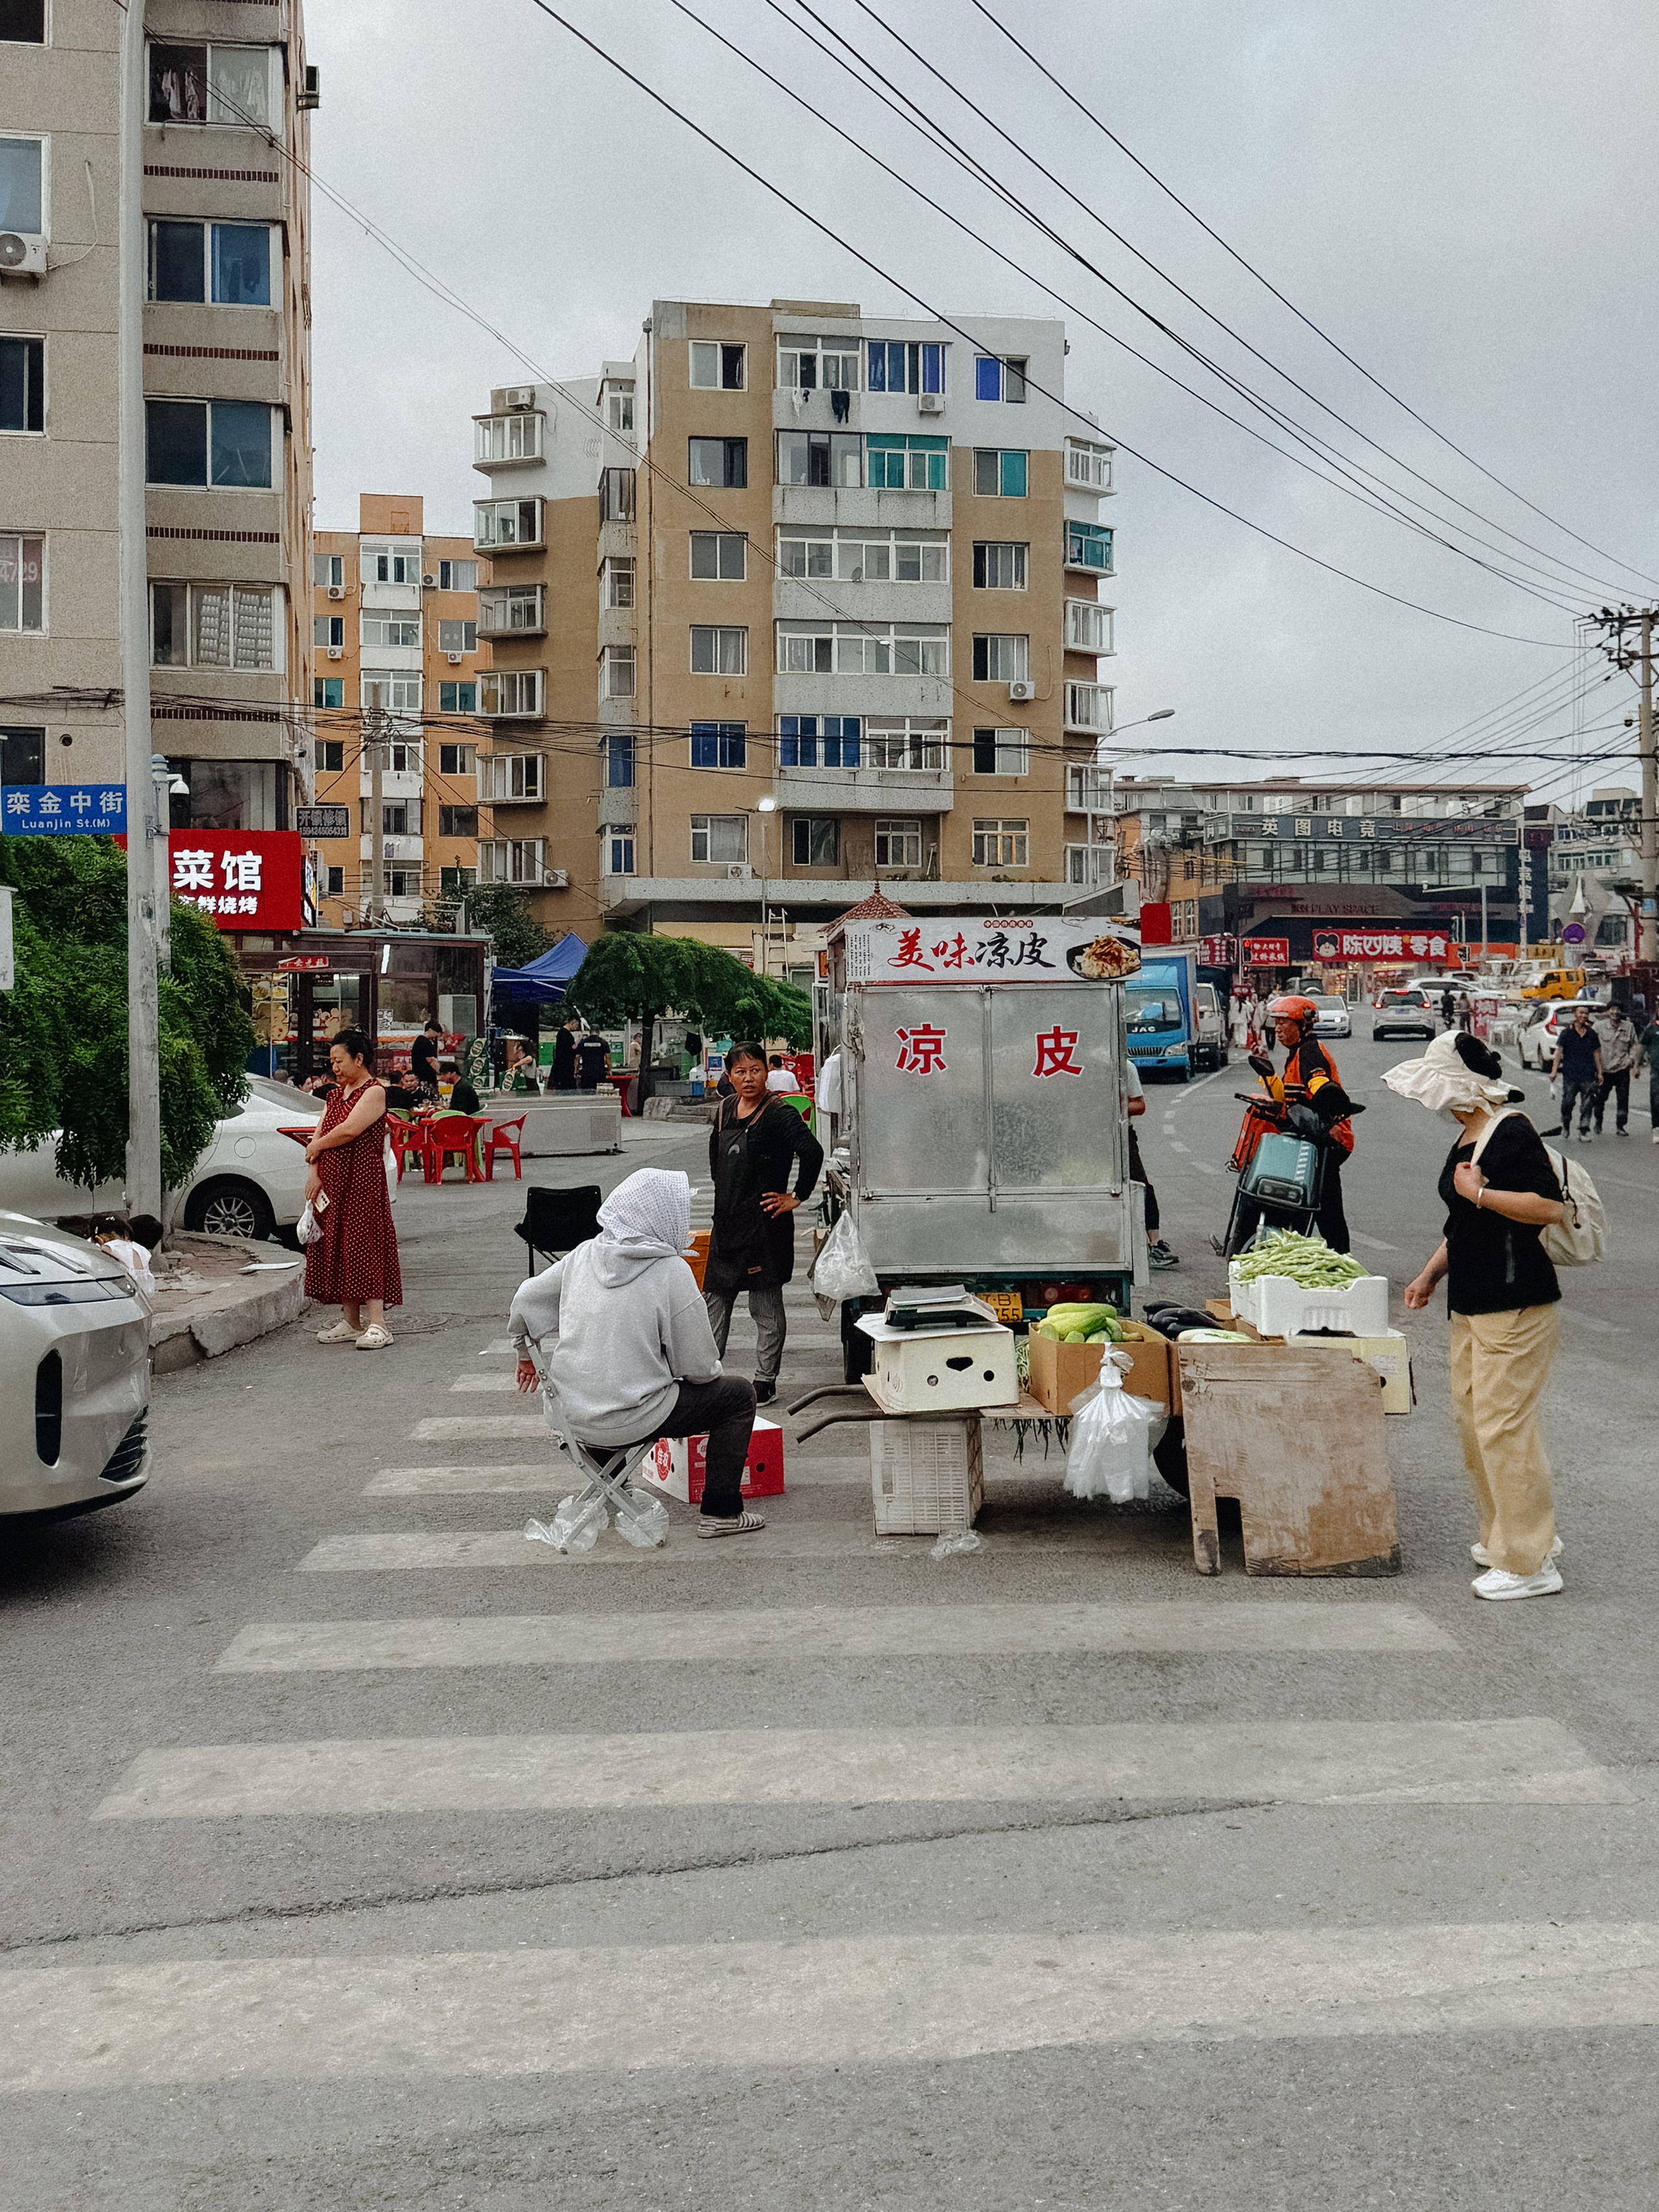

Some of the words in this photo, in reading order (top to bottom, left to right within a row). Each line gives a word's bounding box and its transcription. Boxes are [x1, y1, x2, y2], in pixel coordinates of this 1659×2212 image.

[7, 791, 123, 814] 栾金中街
[22, 819, 71, 830] Luanjin
[76, 818, 110, 828] St.(M)
[1261, 818, 1376, 838] 英图电竞
[173, 849, 262, 891] 菜馆
[887, 927, 1057, 972] 美味凉皮
[1342, 934, 1448, 957] 陈四姨零食
